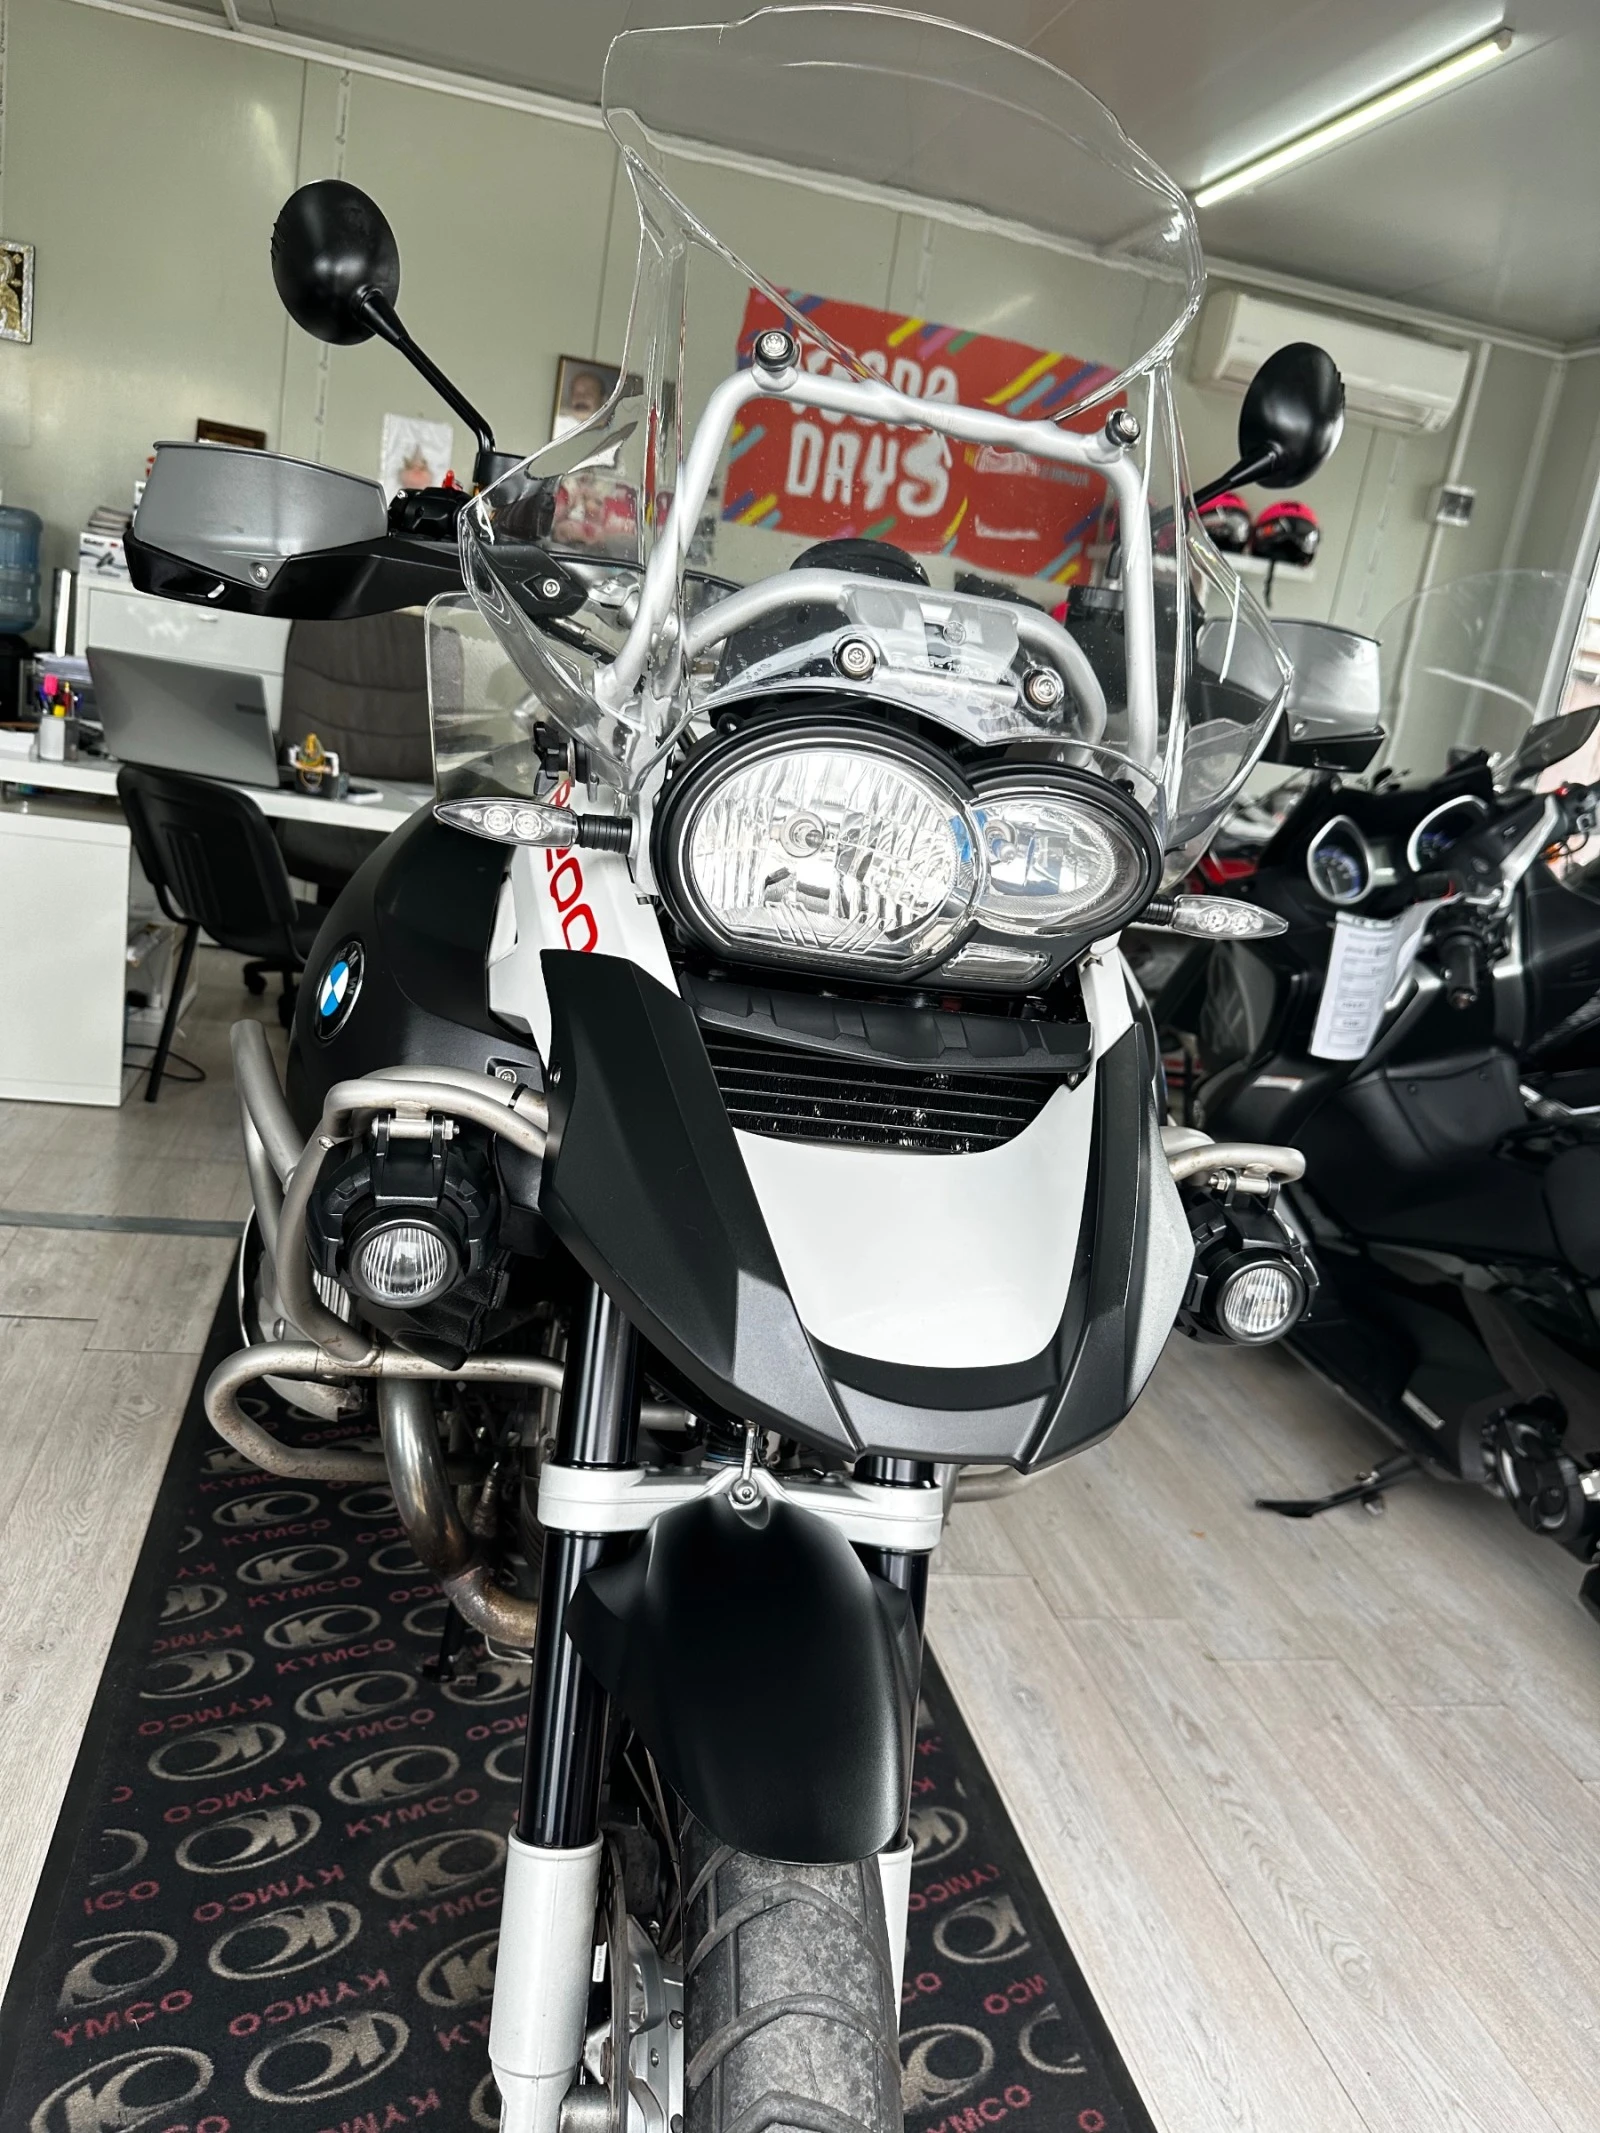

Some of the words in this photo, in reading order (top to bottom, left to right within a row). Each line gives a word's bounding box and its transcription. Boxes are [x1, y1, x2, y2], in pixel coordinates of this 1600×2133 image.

[785, 420, 950, 517] DAYS
[198, 1472, 281, 1492] KYMC
[222, 1519, 331, 1547] KYMCO
[247, 1576, 362, 1608] KYMCO
[276, 1639, 396, 1675] KYMCO
[138, 1694, 273, 1735] KYMCO
[307, 1708, 435, 1750] KYMCO
[163, 1772, 307, 1823] KYMCO
[345, 1788, 479, 1838] KYMCO
[193, 1864, 345, 1922] KYMCO
[388, 1887, 501, 1937] KYMC
[228, 1968, 390, 2037] KYMCO
